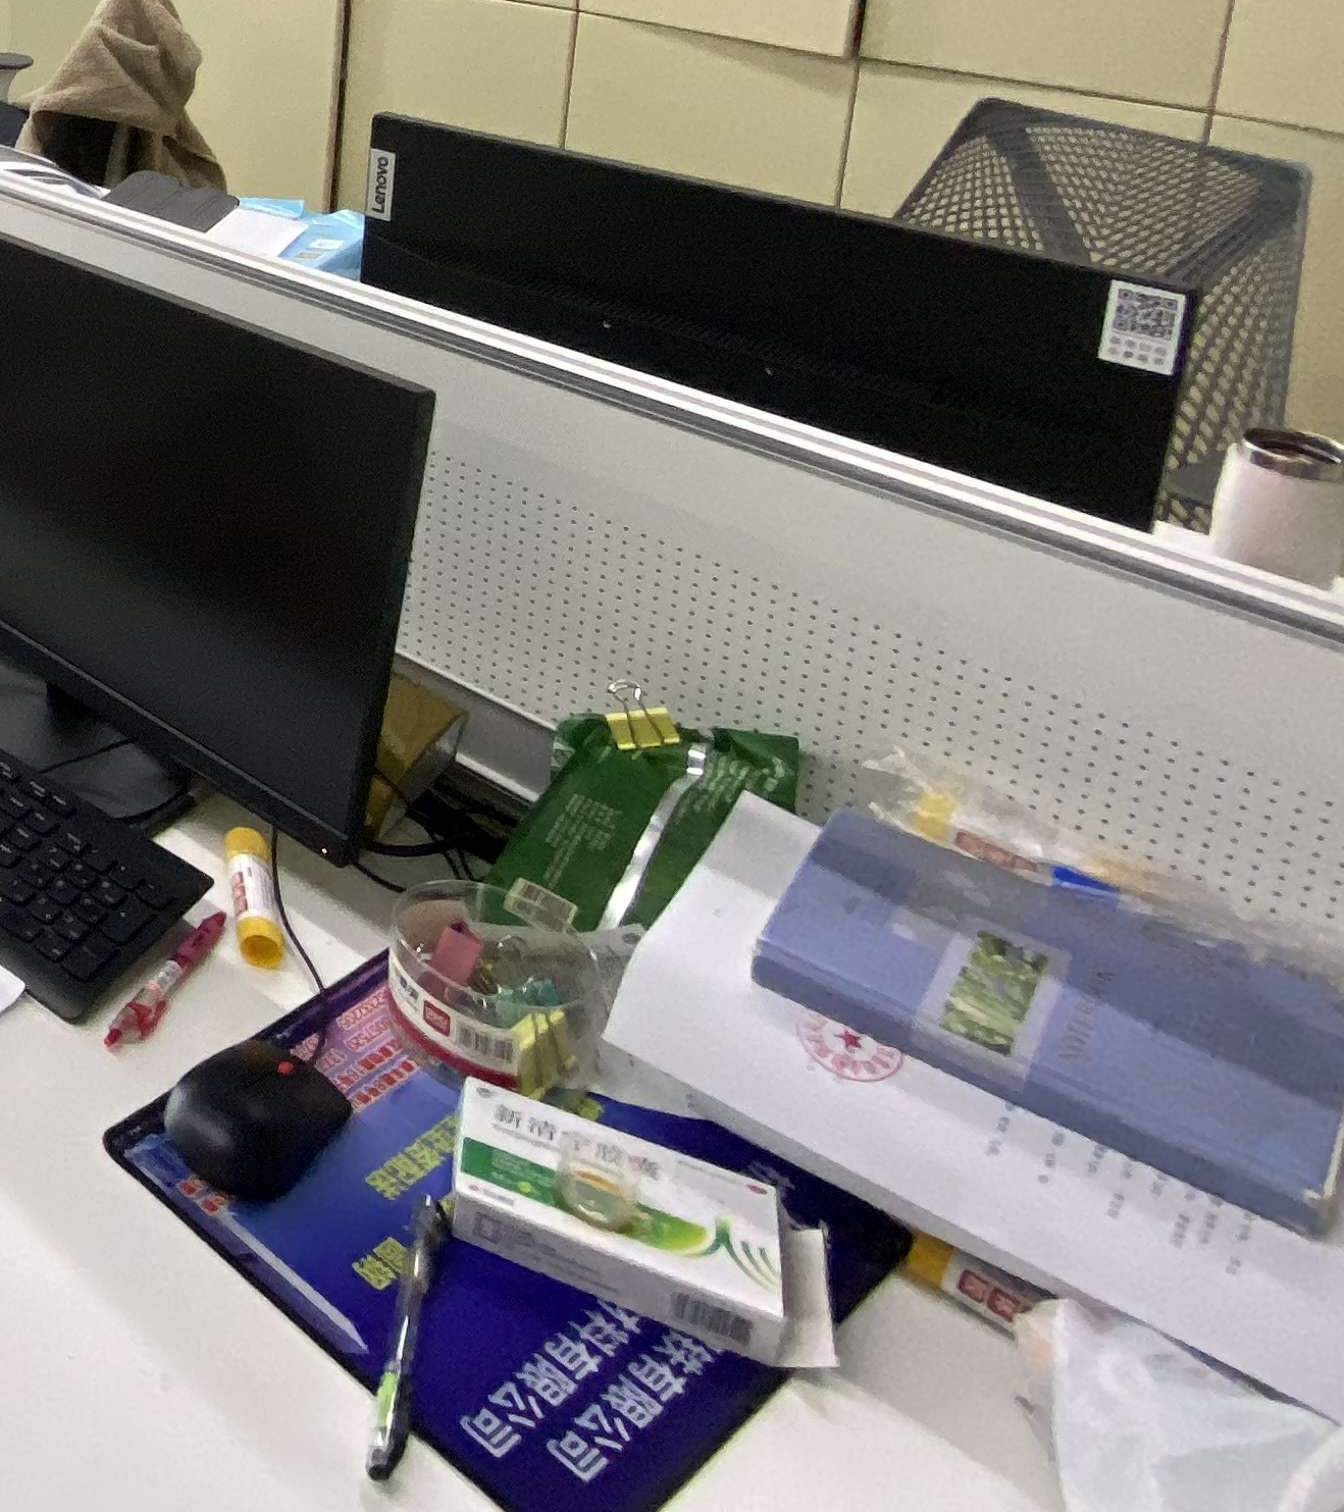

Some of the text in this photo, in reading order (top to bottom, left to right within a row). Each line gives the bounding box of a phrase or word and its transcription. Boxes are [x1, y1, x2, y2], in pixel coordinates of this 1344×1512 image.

[372, 156, 389, 213] Lenovo
[546, 1326, 724, 1483] 铁有限公司
